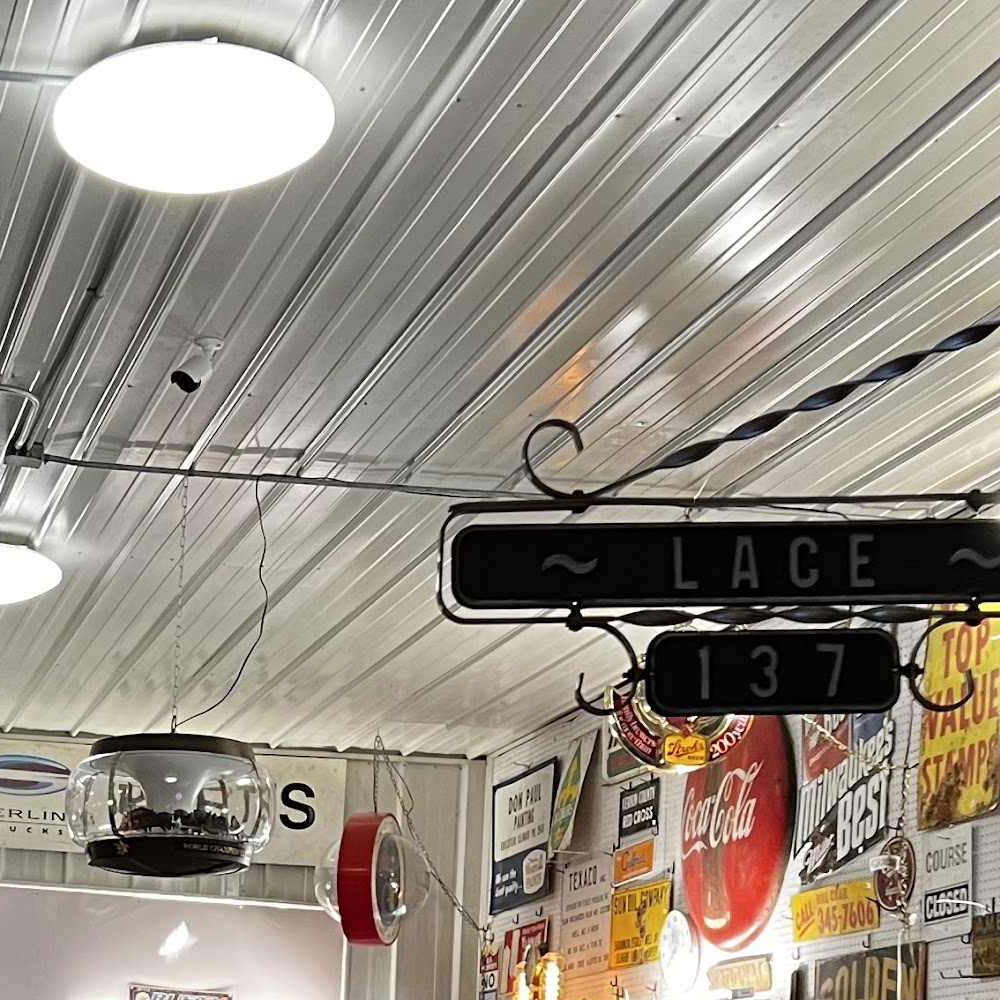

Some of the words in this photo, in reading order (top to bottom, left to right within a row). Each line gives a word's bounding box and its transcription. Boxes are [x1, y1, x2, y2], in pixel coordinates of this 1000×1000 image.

[673, 534, 876, 590] LACE
[943, 617, 991, 679] TOP
[698, 643, 846, 700] 137
[926, 668, 1000, 740] VALUE
[508, 791, 524, 816] DON
[526, 782, 542, 808] PAUL
[633, 805, 654, 825] CROSS
[925, 842, 968, 874] COURSE
[569, 865, 598, 893] TEXACO
[614, 896, 627, 916] SUN
[925, 887, 968, 920] CLOSED
